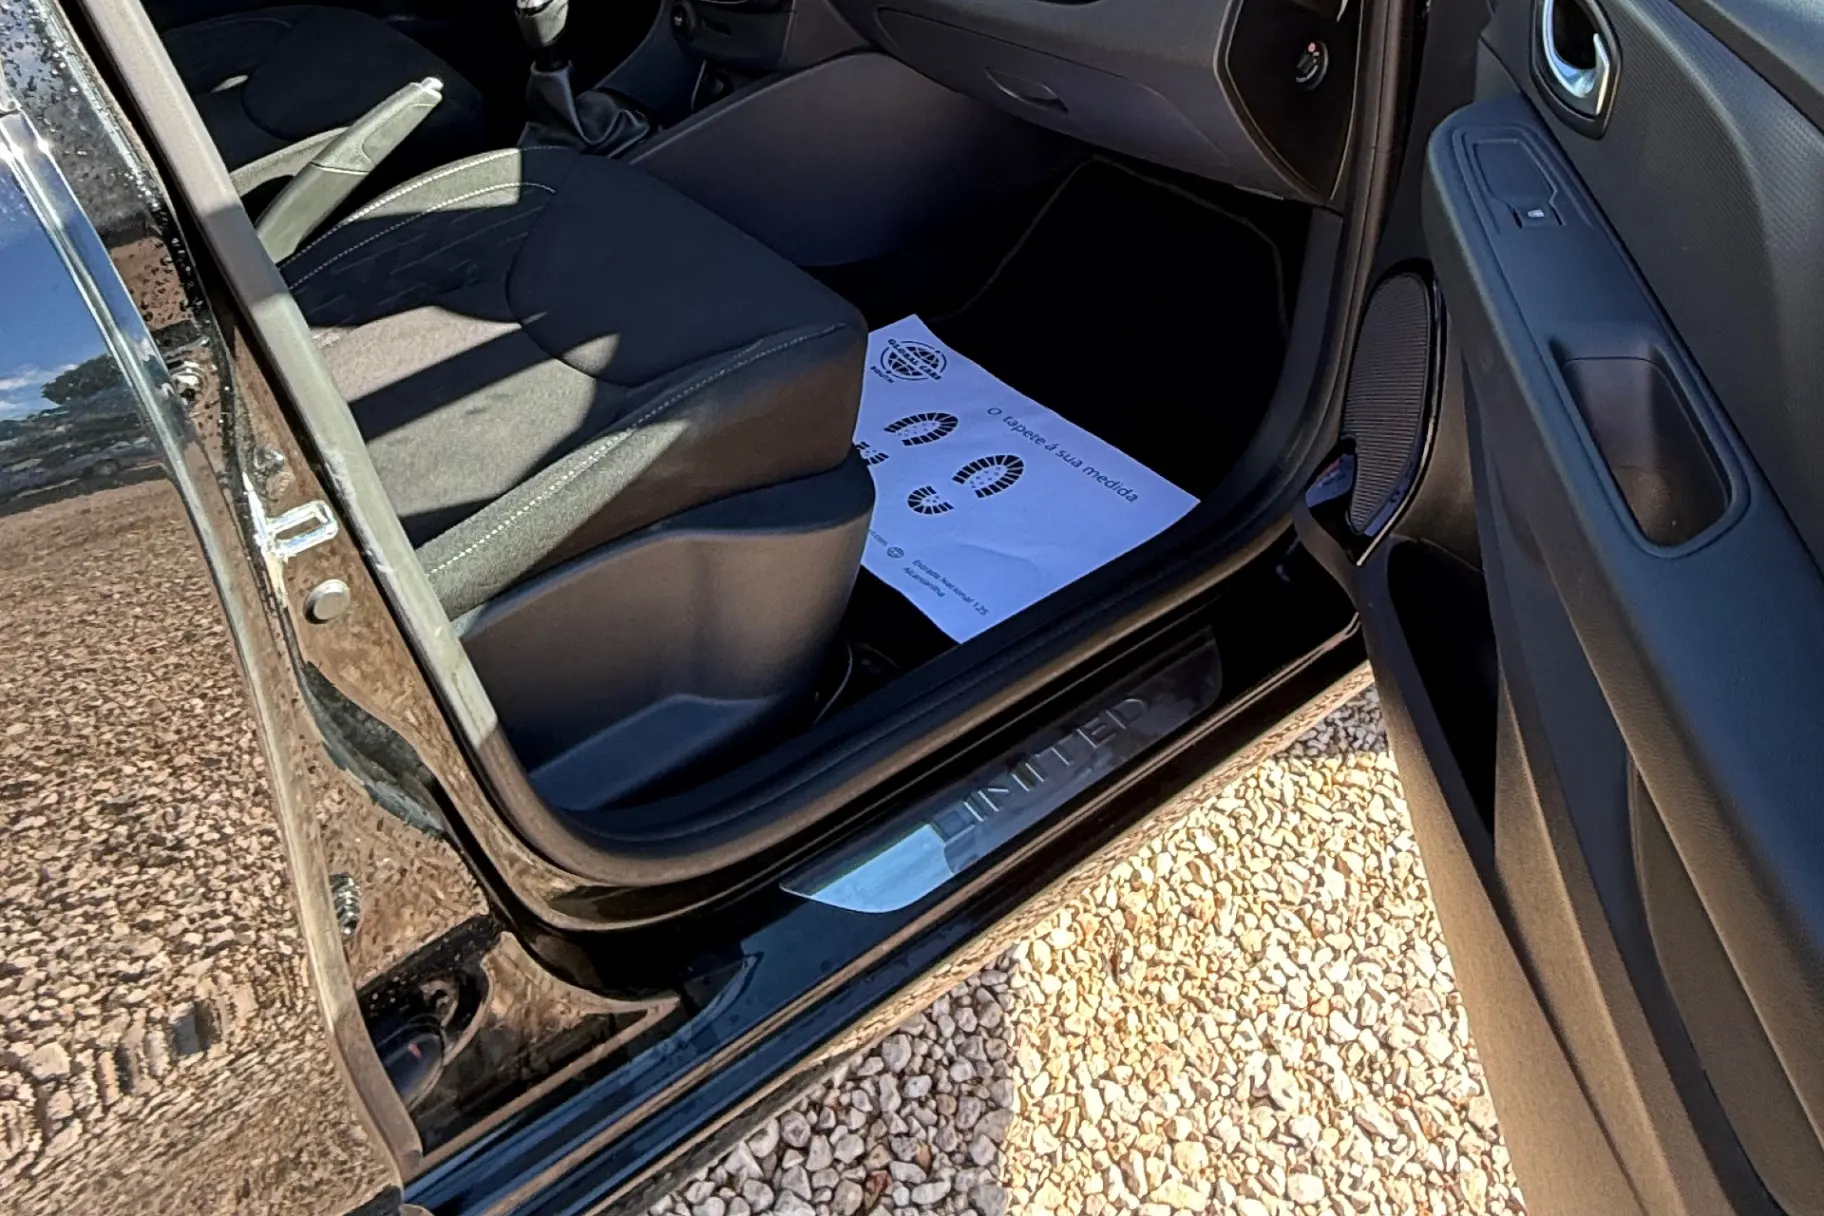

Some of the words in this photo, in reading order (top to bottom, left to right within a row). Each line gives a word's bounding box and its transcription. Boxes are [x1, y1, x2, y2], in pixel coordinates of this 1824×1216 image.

[887, 339, 920, 366] GLOBAL
[986, 407, 1003, 416] O
[1002, 415, 1047, 446] tapete
[1055, 449, 1084, 469] sua
[1082, 466, 1139, 503] medida
[931, 698, 1146, 847] LIMITED
